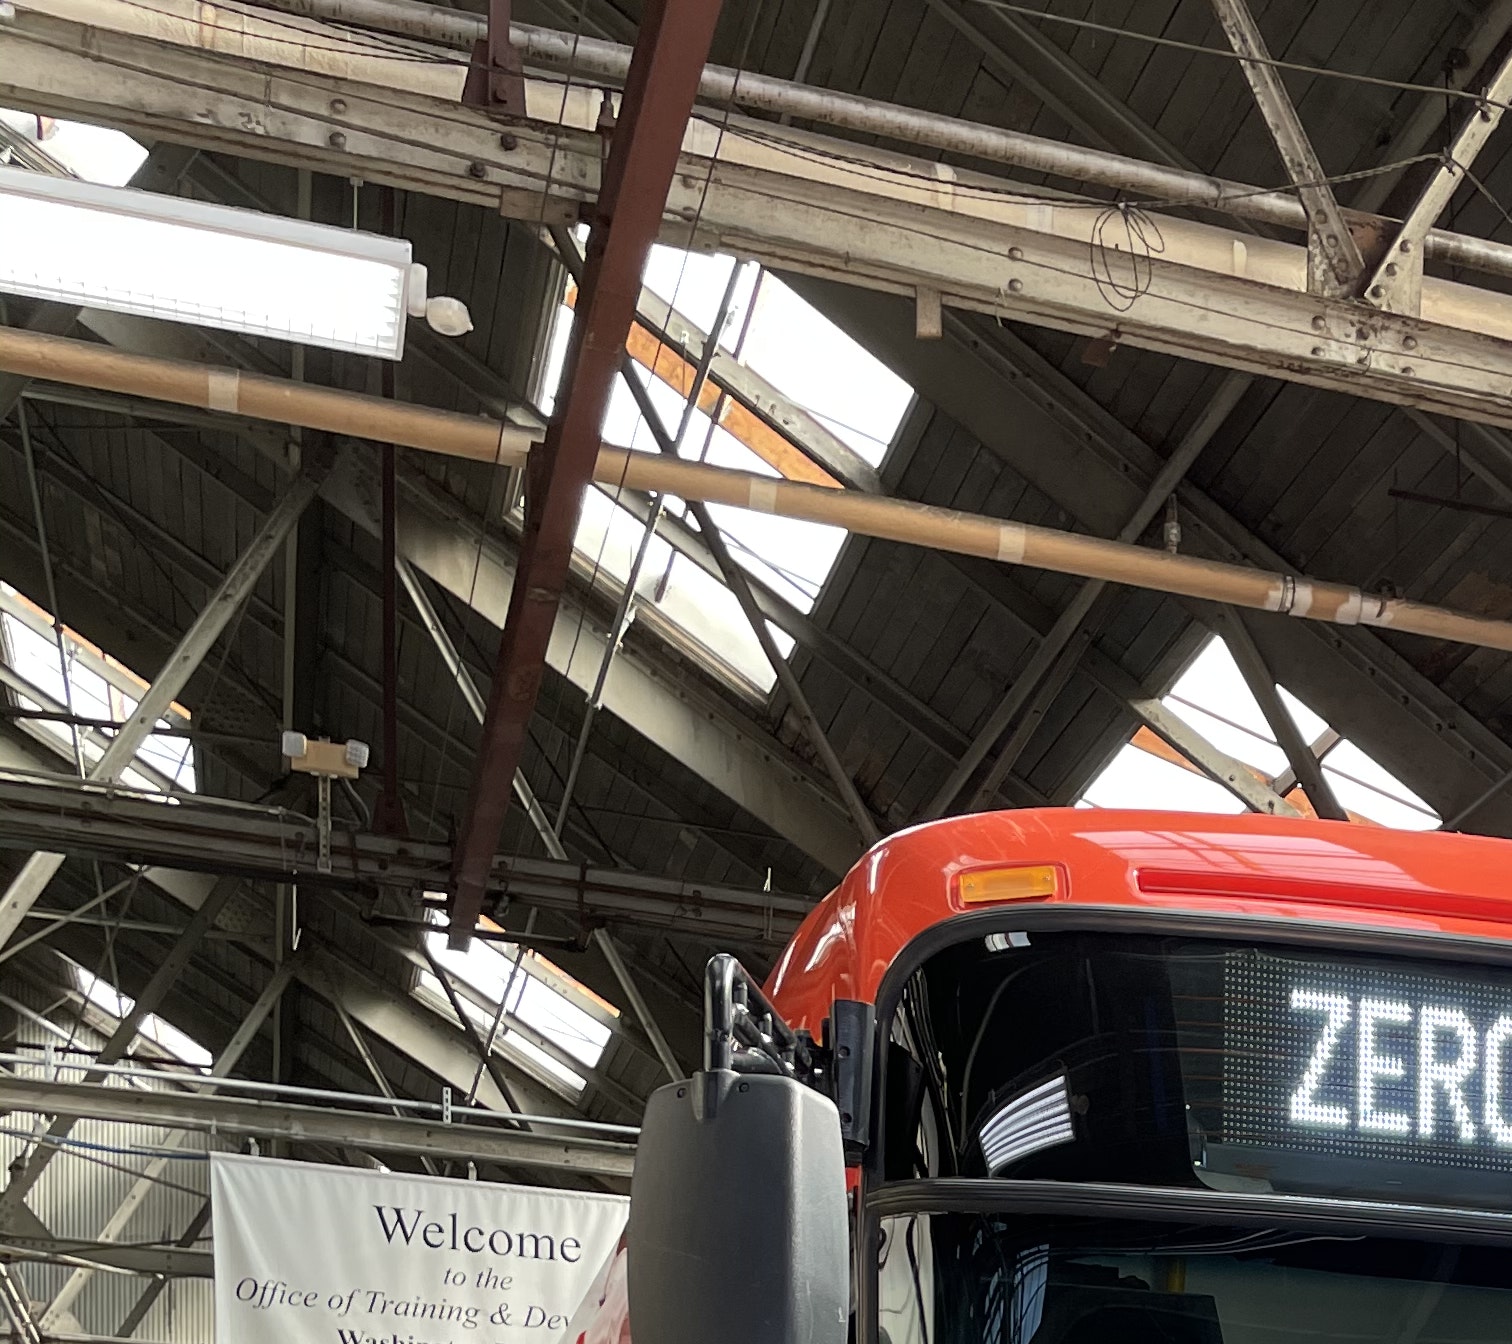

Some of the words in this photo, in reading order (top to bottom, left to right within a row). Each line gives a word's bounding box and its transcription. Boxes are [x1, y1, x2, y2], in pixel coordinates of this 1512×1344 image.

[373, 1205, 582, 1263] Welcome
[236, 1277, 318, 1309] Office
[328, 1289, 361, 1317] of
[366, 1290, 480, 1330] Training
[490, 1302, 513, 1326] &
[444, 1267, 466, 1286] to
[476, 1267, 513, 1290] the
